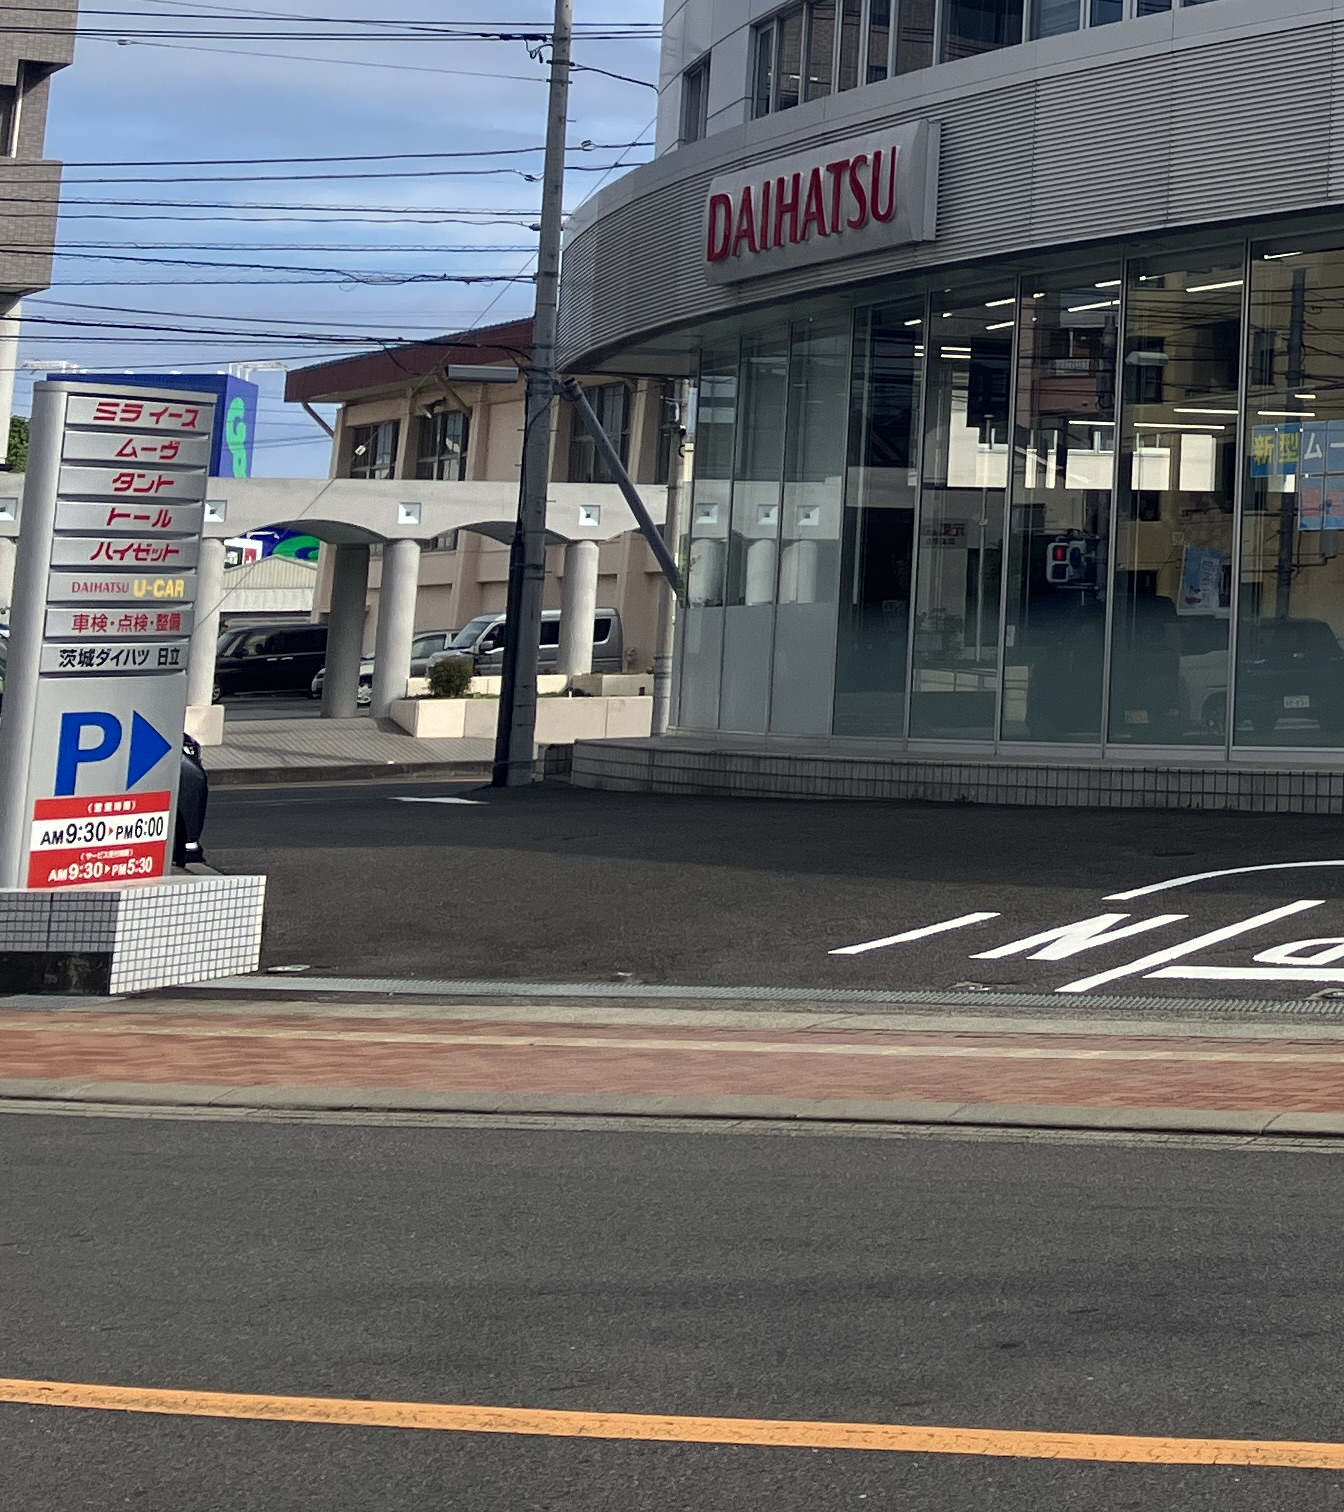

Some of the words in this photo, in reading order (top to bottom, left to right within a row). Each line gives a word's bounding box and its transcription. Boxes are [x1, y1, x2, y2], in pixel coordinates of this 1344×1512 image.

[706, 144, 899, 263] DAIHATSU
[115, 438, 181, 460] ムーヴ
[112, 472, 175, 493] タント
[106, 507, 172, 528] トール
[89, 541, 180, 562] ハイゼット
[71, 581, 130, 594] DAIHATSU
[133, 578, 185, 598] U-CAR
[58, 648, 150, 668] 茨城ダイハツ
[157, 647, 181, 666] 日立
[54, 711, 123, 797] P
